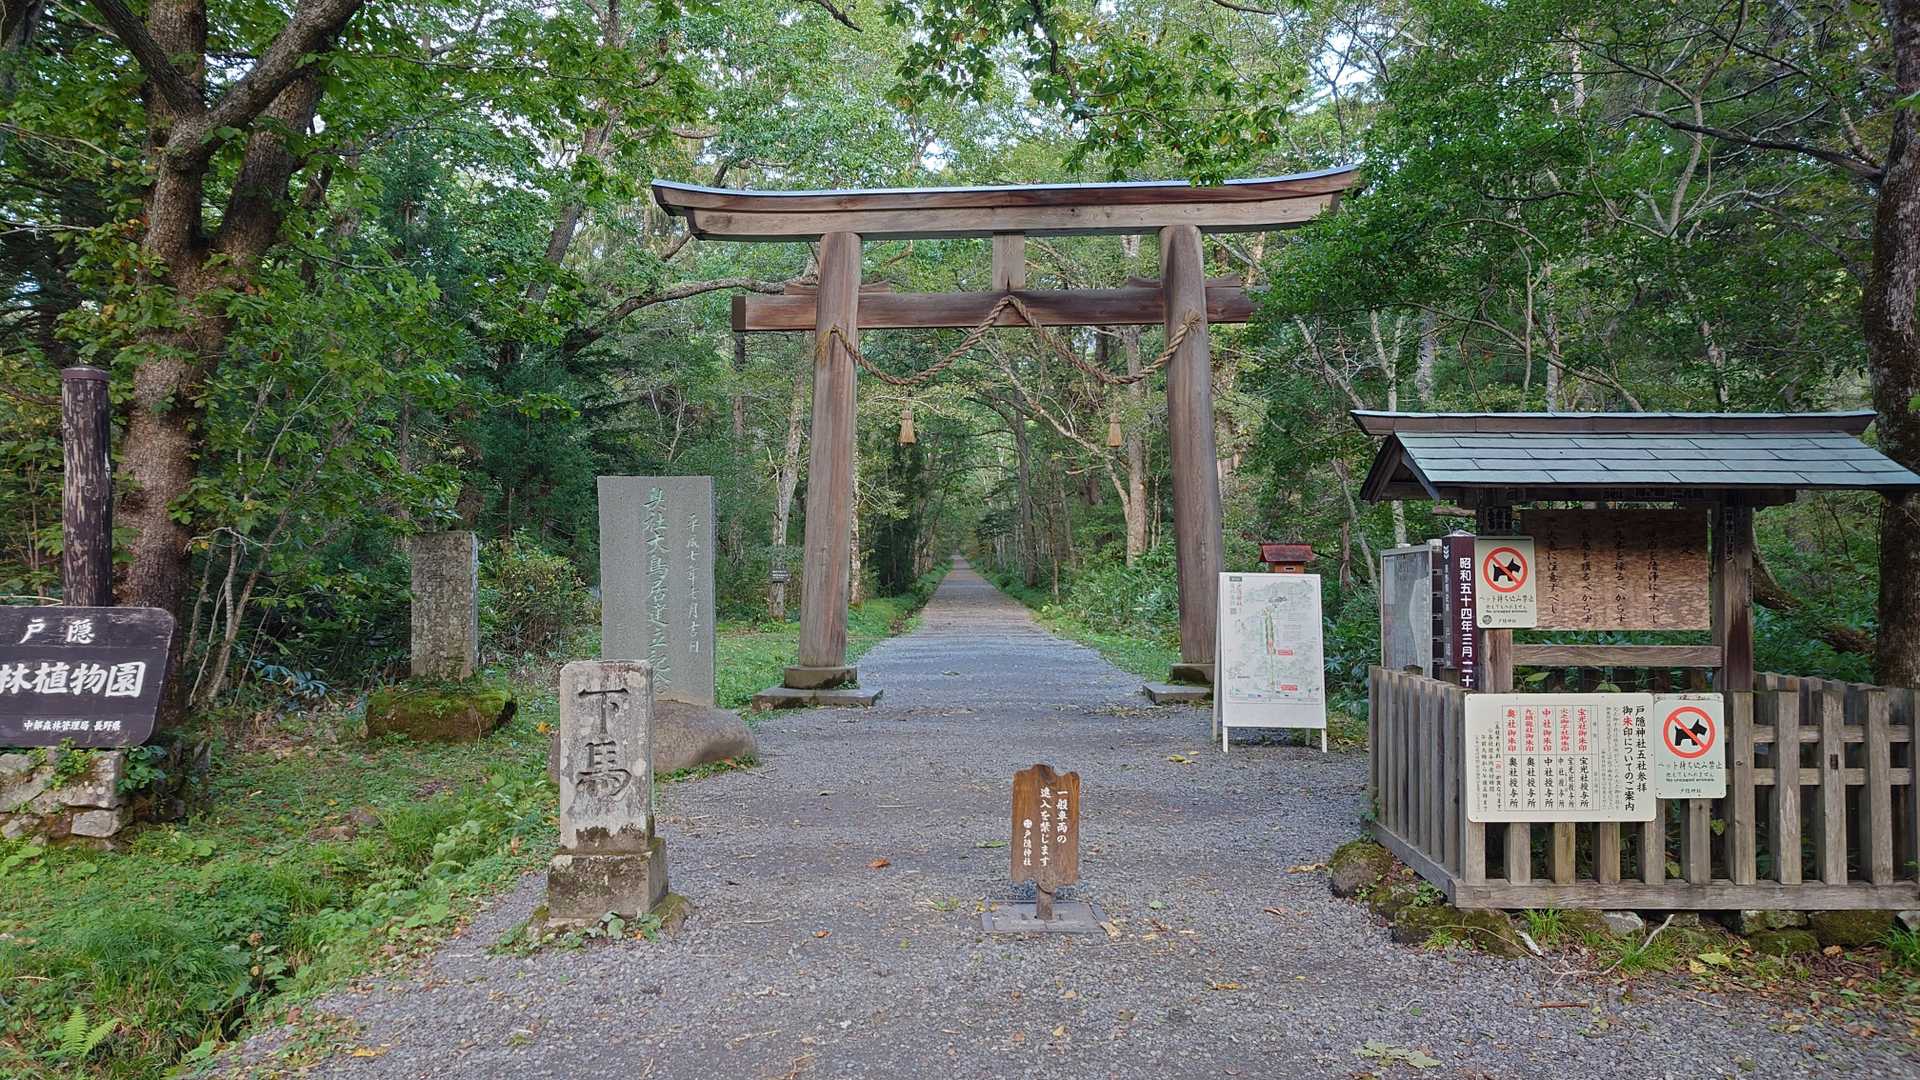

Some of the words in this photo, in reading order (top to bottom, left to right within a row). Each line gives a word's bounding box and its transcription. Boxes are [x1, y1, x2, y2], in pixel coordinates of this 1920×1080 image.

[1039, 786, 1052, 867] 進入を禁じます
[1056, 790, 1069, 844] 一般車両の
